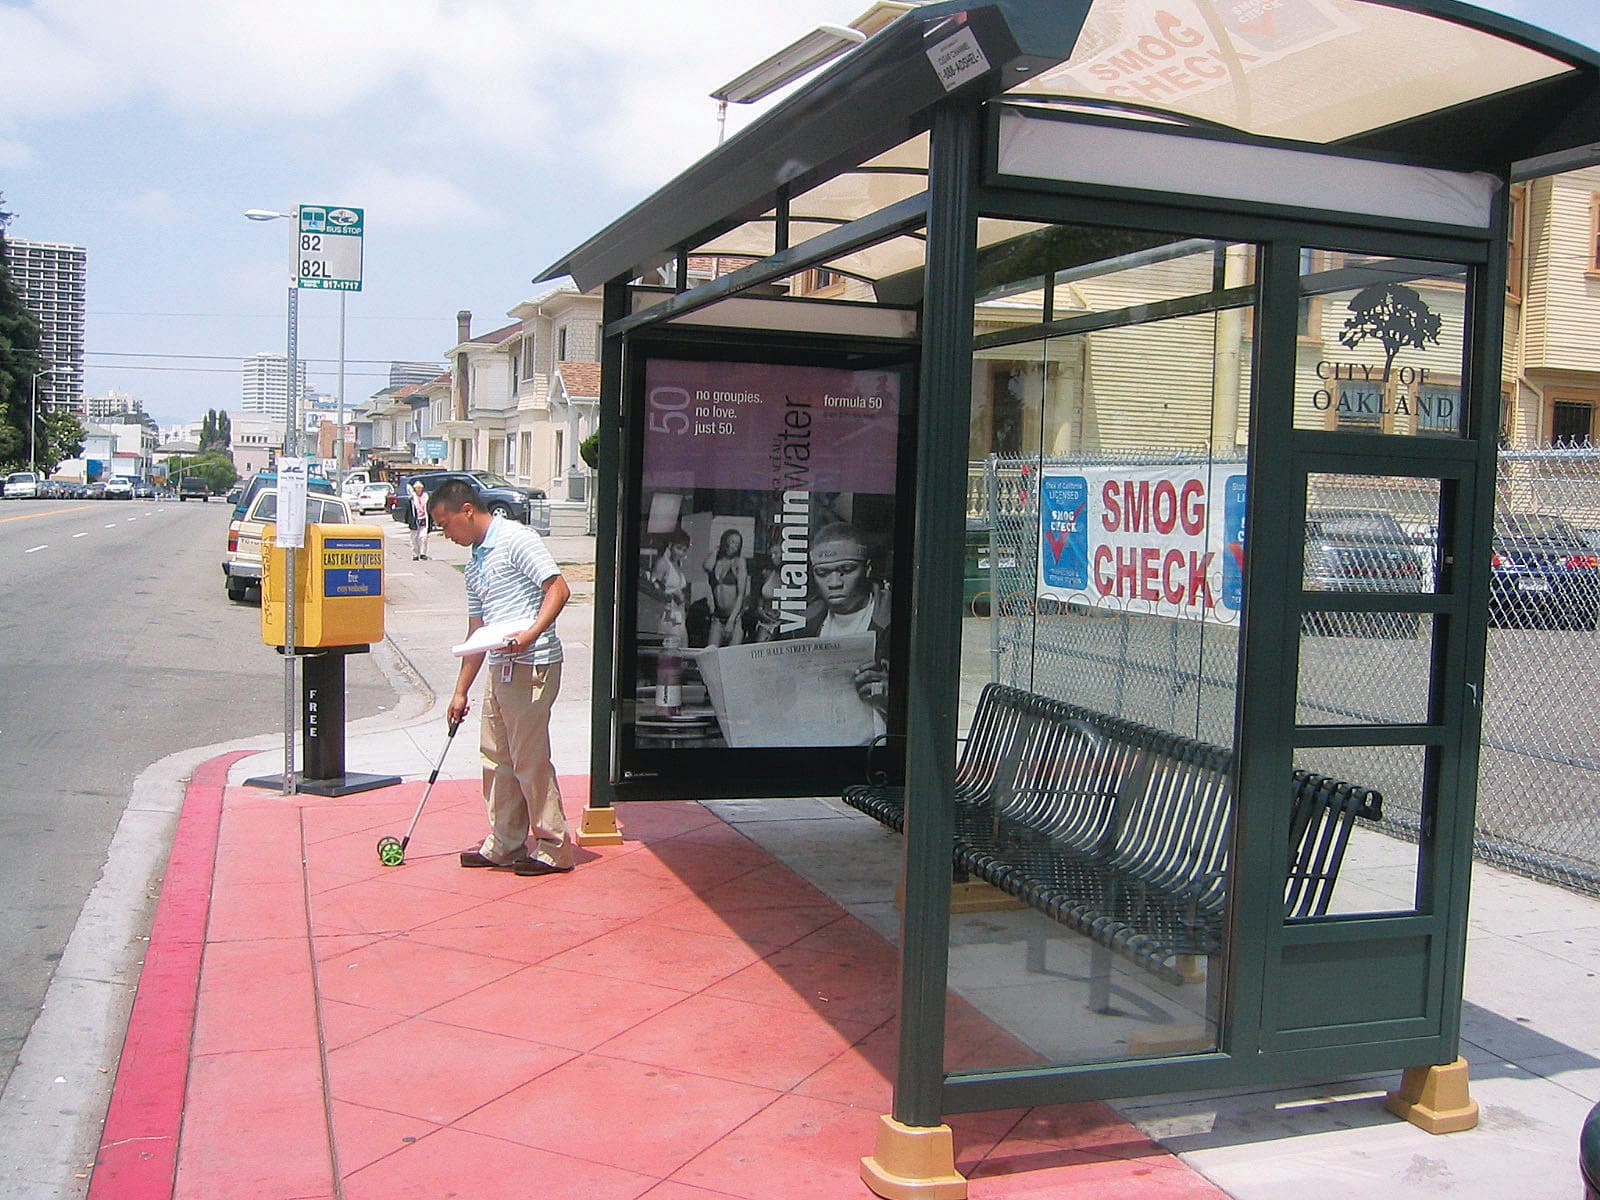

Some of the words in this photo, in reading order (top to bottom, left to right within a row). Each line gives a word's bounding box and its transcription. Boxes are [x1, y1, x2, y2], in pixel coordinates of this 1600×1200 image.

[1088, 10, 1205, 81] SMOG
[343, 226, 361, 234] STOP
[301, 235, 321, 251] 82
[301, 260, 331, 278] 82L
[1316, 361, 1374, 381] CITY
[1400, 367, 1431, 385] OF
[696, 391, 710, 400] no
[713, 391, 763, 405] groupies.
[824, 394, 867, 409] formula
[868, 397, 883, 409] 50
[1313, 390, 1454, 418] OAKLAND
[649, 386, 691, 435] 50
[695, 407, 710, 417] no
[712, 405, 737, 418] love.
[694, 421, 716, 436] just
[718, 423, 736, 435] 50.
[1049, 490, 1079, 500] LICENSED
[1051, 510, 1075, 521] SMOG
[1102, 479, 1205, 536] SMOG
[324, 554, 339, 566] EAST
[340, 554, 353, 566] BAY
[354, 554, 382, 569] express
[1094, 545, 1216, 608] CHECK
[309, 690, 318, 737] FREE
